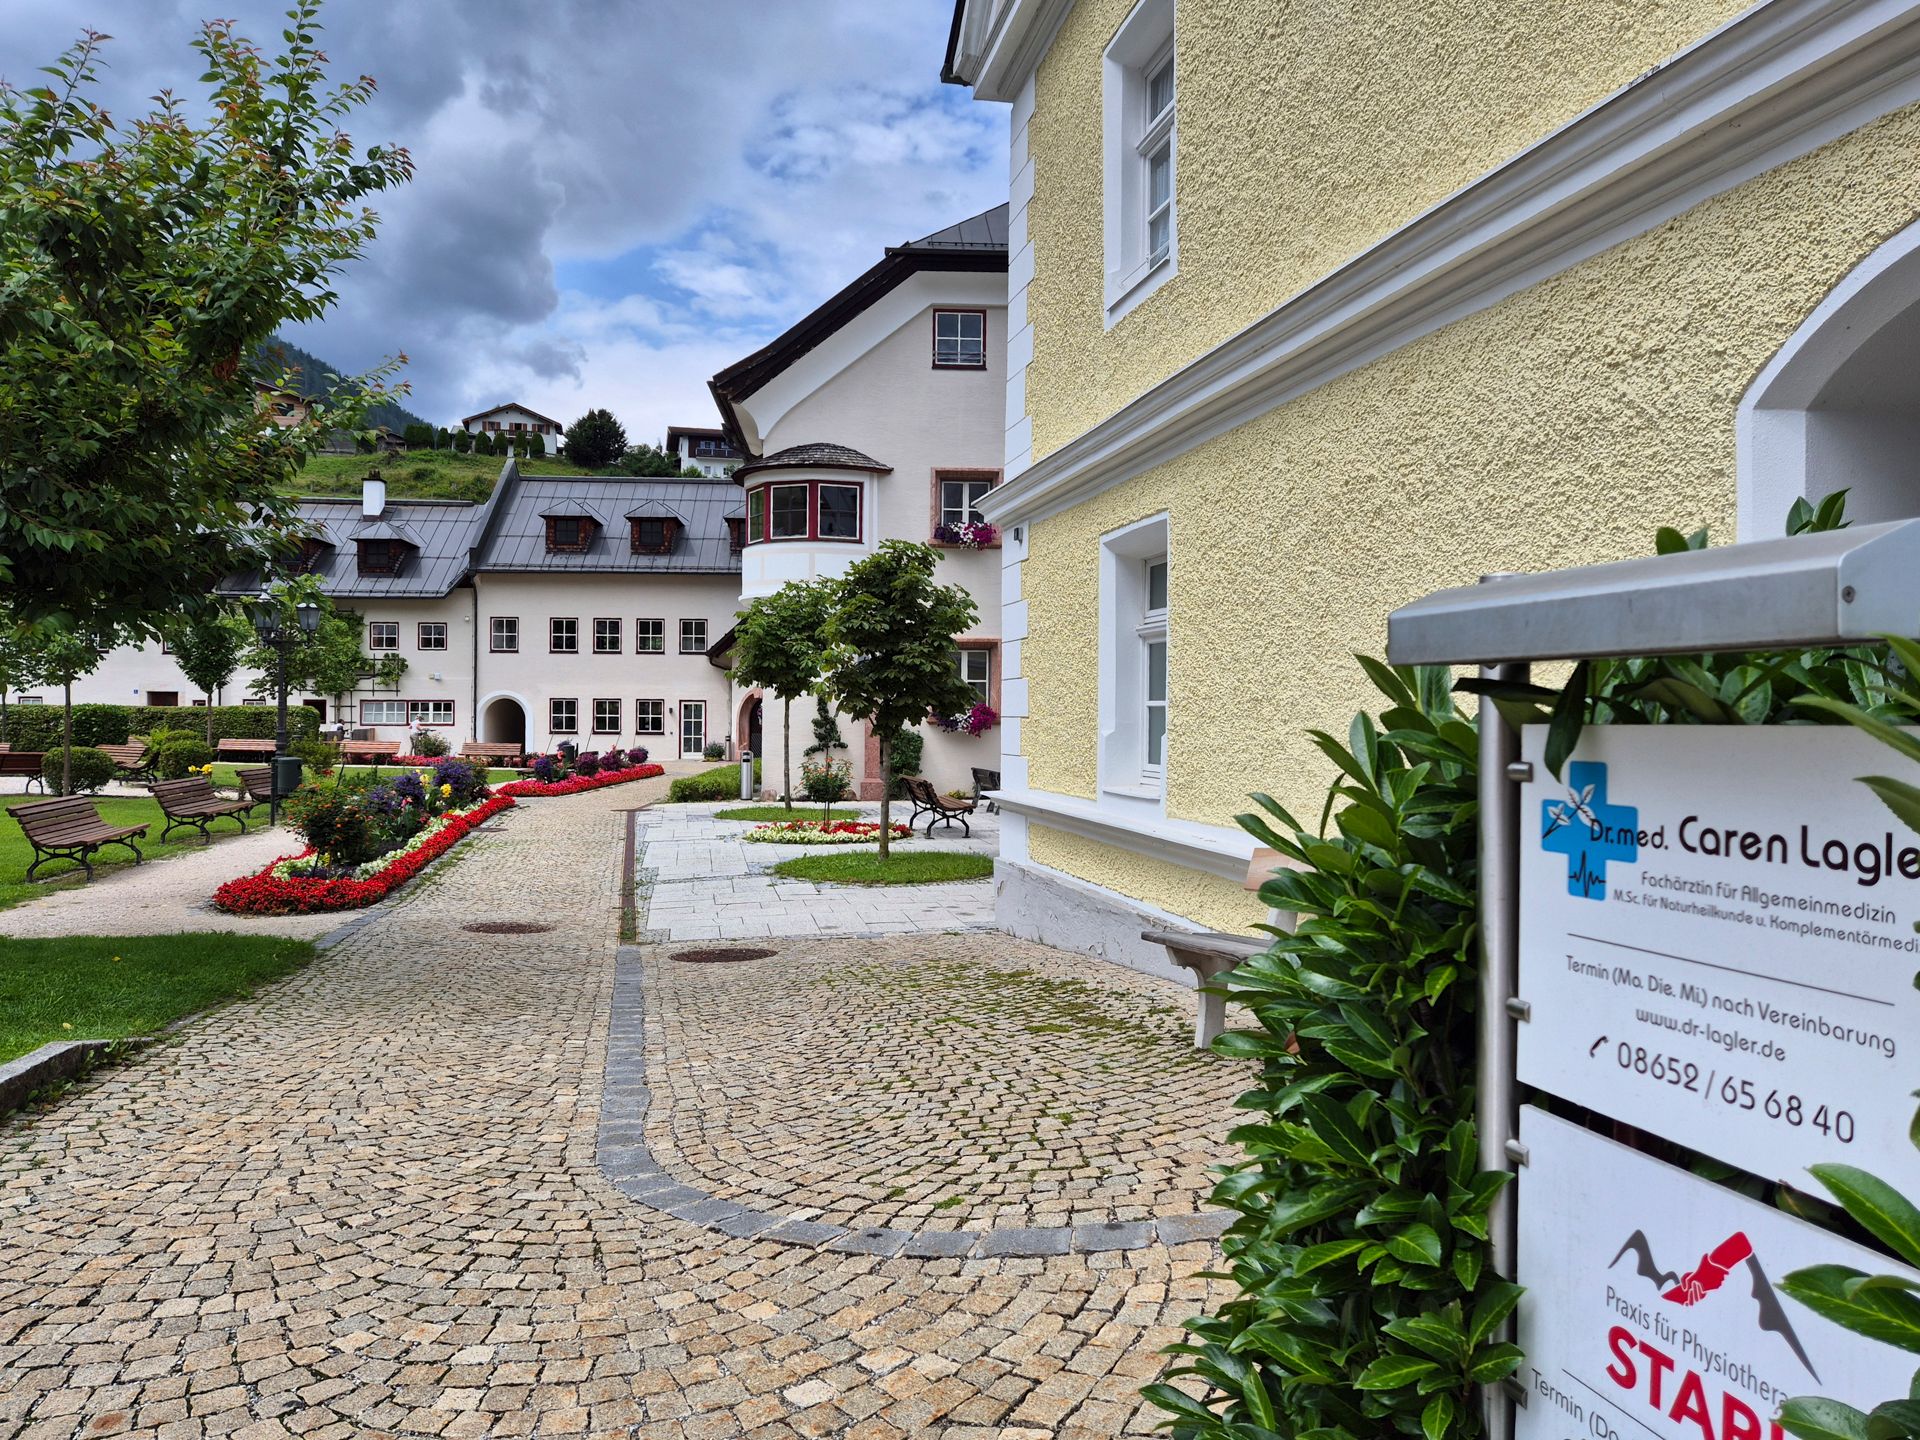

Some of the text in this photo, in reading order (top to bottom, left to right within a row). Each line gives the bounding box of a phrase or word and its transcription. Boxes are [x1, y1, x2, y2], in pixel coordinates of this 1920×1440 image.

[1679, 815, 1788, 864] Caren
[1613, 889, 1920, 953] M.Sc. für Naturheilkunde u. Komplementärmedi
[1641, 871, 1896, 924] Fachärztin für Allgemeinmedizin
[1566, 954, 1896, 1058] Termin (Mo. Die. Mi.) nach Vereinbarung
[1636, 1009, 1786, 1061] www.dr-lagler.de
[1618, 1042, 1699, 1092] 08652
[1721, 1076, 1756, 1110] 65
[1764, 1090, 1803, 1127] 68
[1812, 1105, 1854, 1144] 40
[1606, 1285, 1789, 1409] Praxis für Physiothera
[1531, 1368, 1583, 1423] Termin
